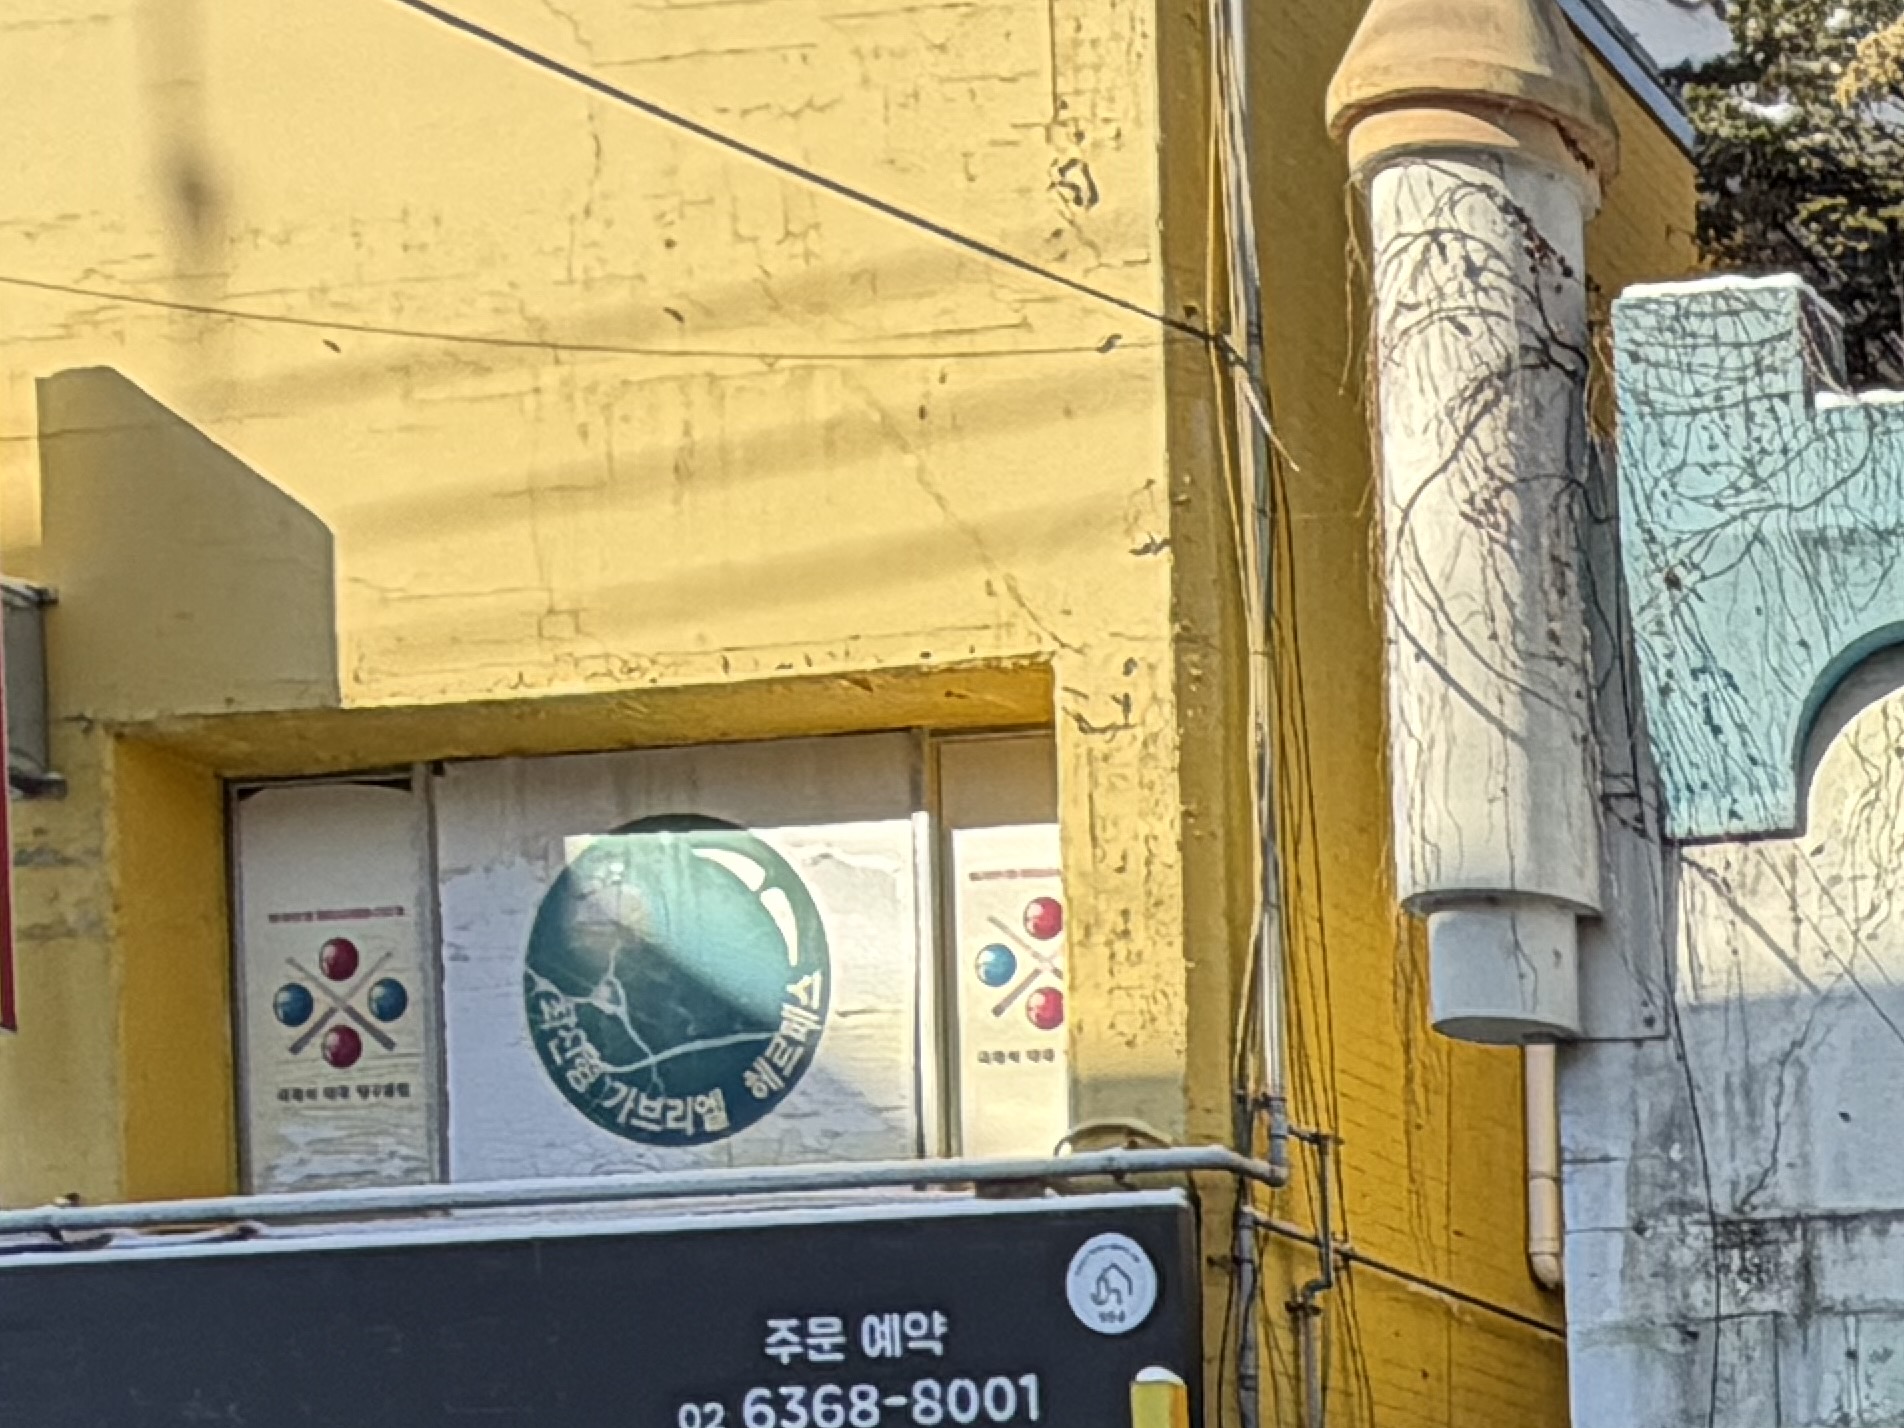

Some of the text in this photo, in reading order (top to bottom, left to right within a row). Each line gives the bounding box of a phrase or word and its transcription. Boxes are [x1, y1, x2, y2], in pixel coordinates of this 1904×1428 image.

[602, 1079, 730, 1136] 가브리엘
[764, 1311, 948, 1364] 주문 예약
